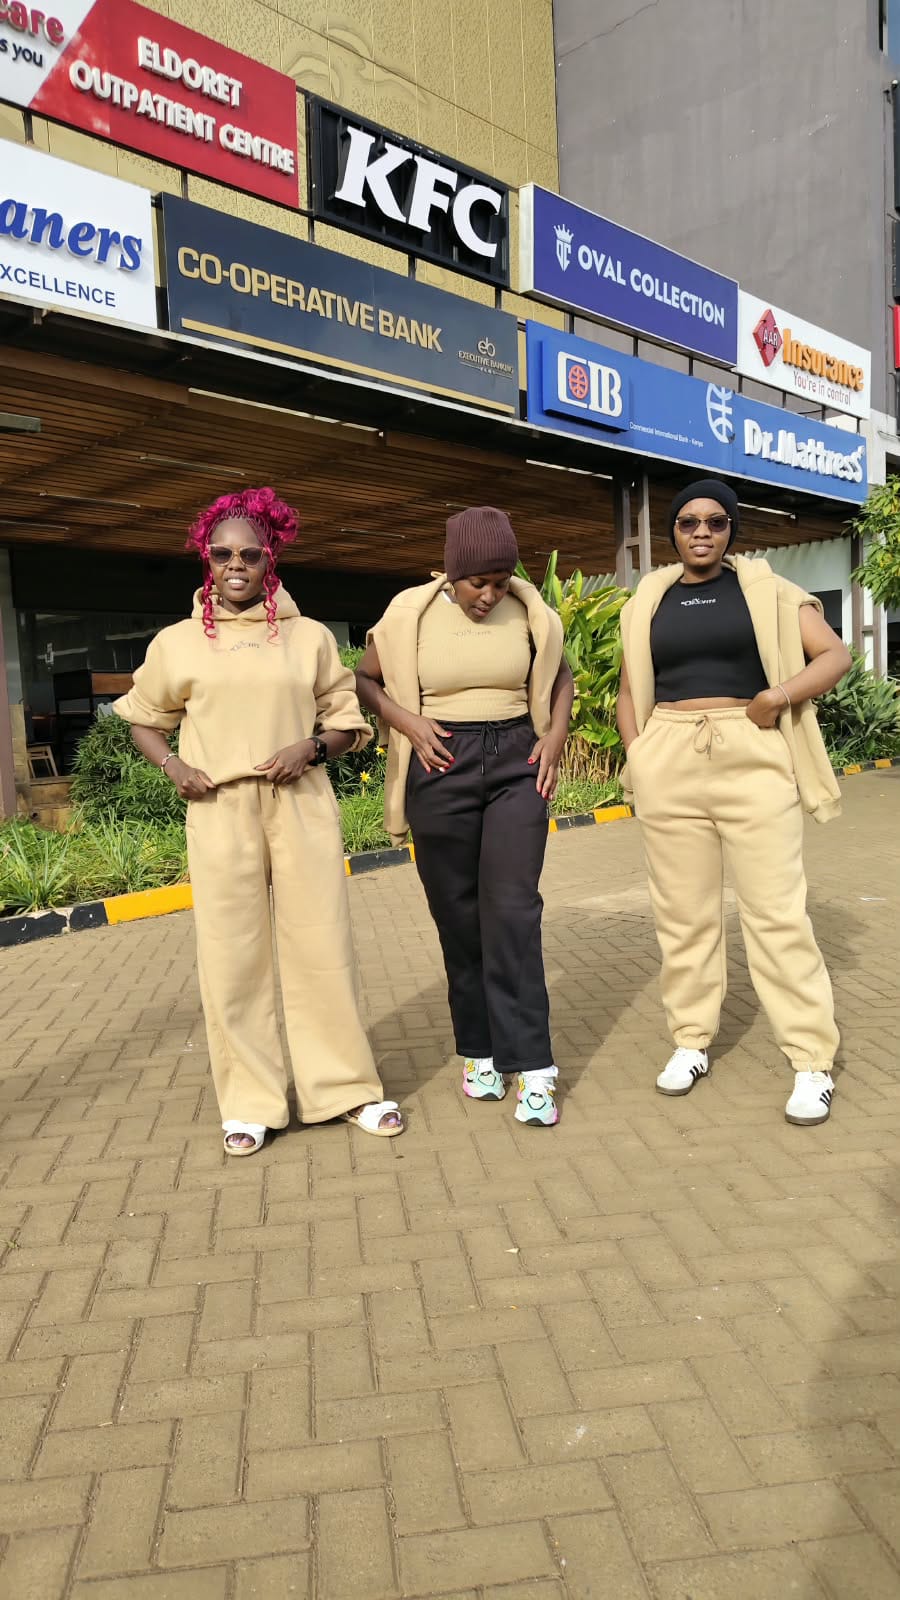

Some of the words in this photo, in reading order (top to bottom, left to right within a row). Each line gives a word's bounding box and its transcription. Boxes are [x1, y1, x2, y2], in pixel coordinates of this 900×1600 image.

[12, 43, 43, 67] you
[138, 36, 243, 107] ELDORET
[69, 60, 216, 142] OUTPATIENT
[219, 123, 294, 175] CENTRE
[334, 125, 502, 258] KFC
[0, 198, 143, 271] aners
[0, 263, 116, 307] XCELLENCE
[177, 246, 374, 331] CO-OPERATIVE
[378, 308, 443, 353] BANK
[578, 244, 626, 286] OVAL
[630, 268, 725, 328] COLLECTION
[458, 350, 490, 367] EXECUTIVE
[490, 359, 514, 374] BANKING
[763, 328, 778, 347] AAR
[783, 328, 864, 392] Insurance
[557, 351, 623, 417] CIB
[793, 370, 816, 393] You're
[818, 380, 825, 396] in
[827, 387, 851, 406] control
